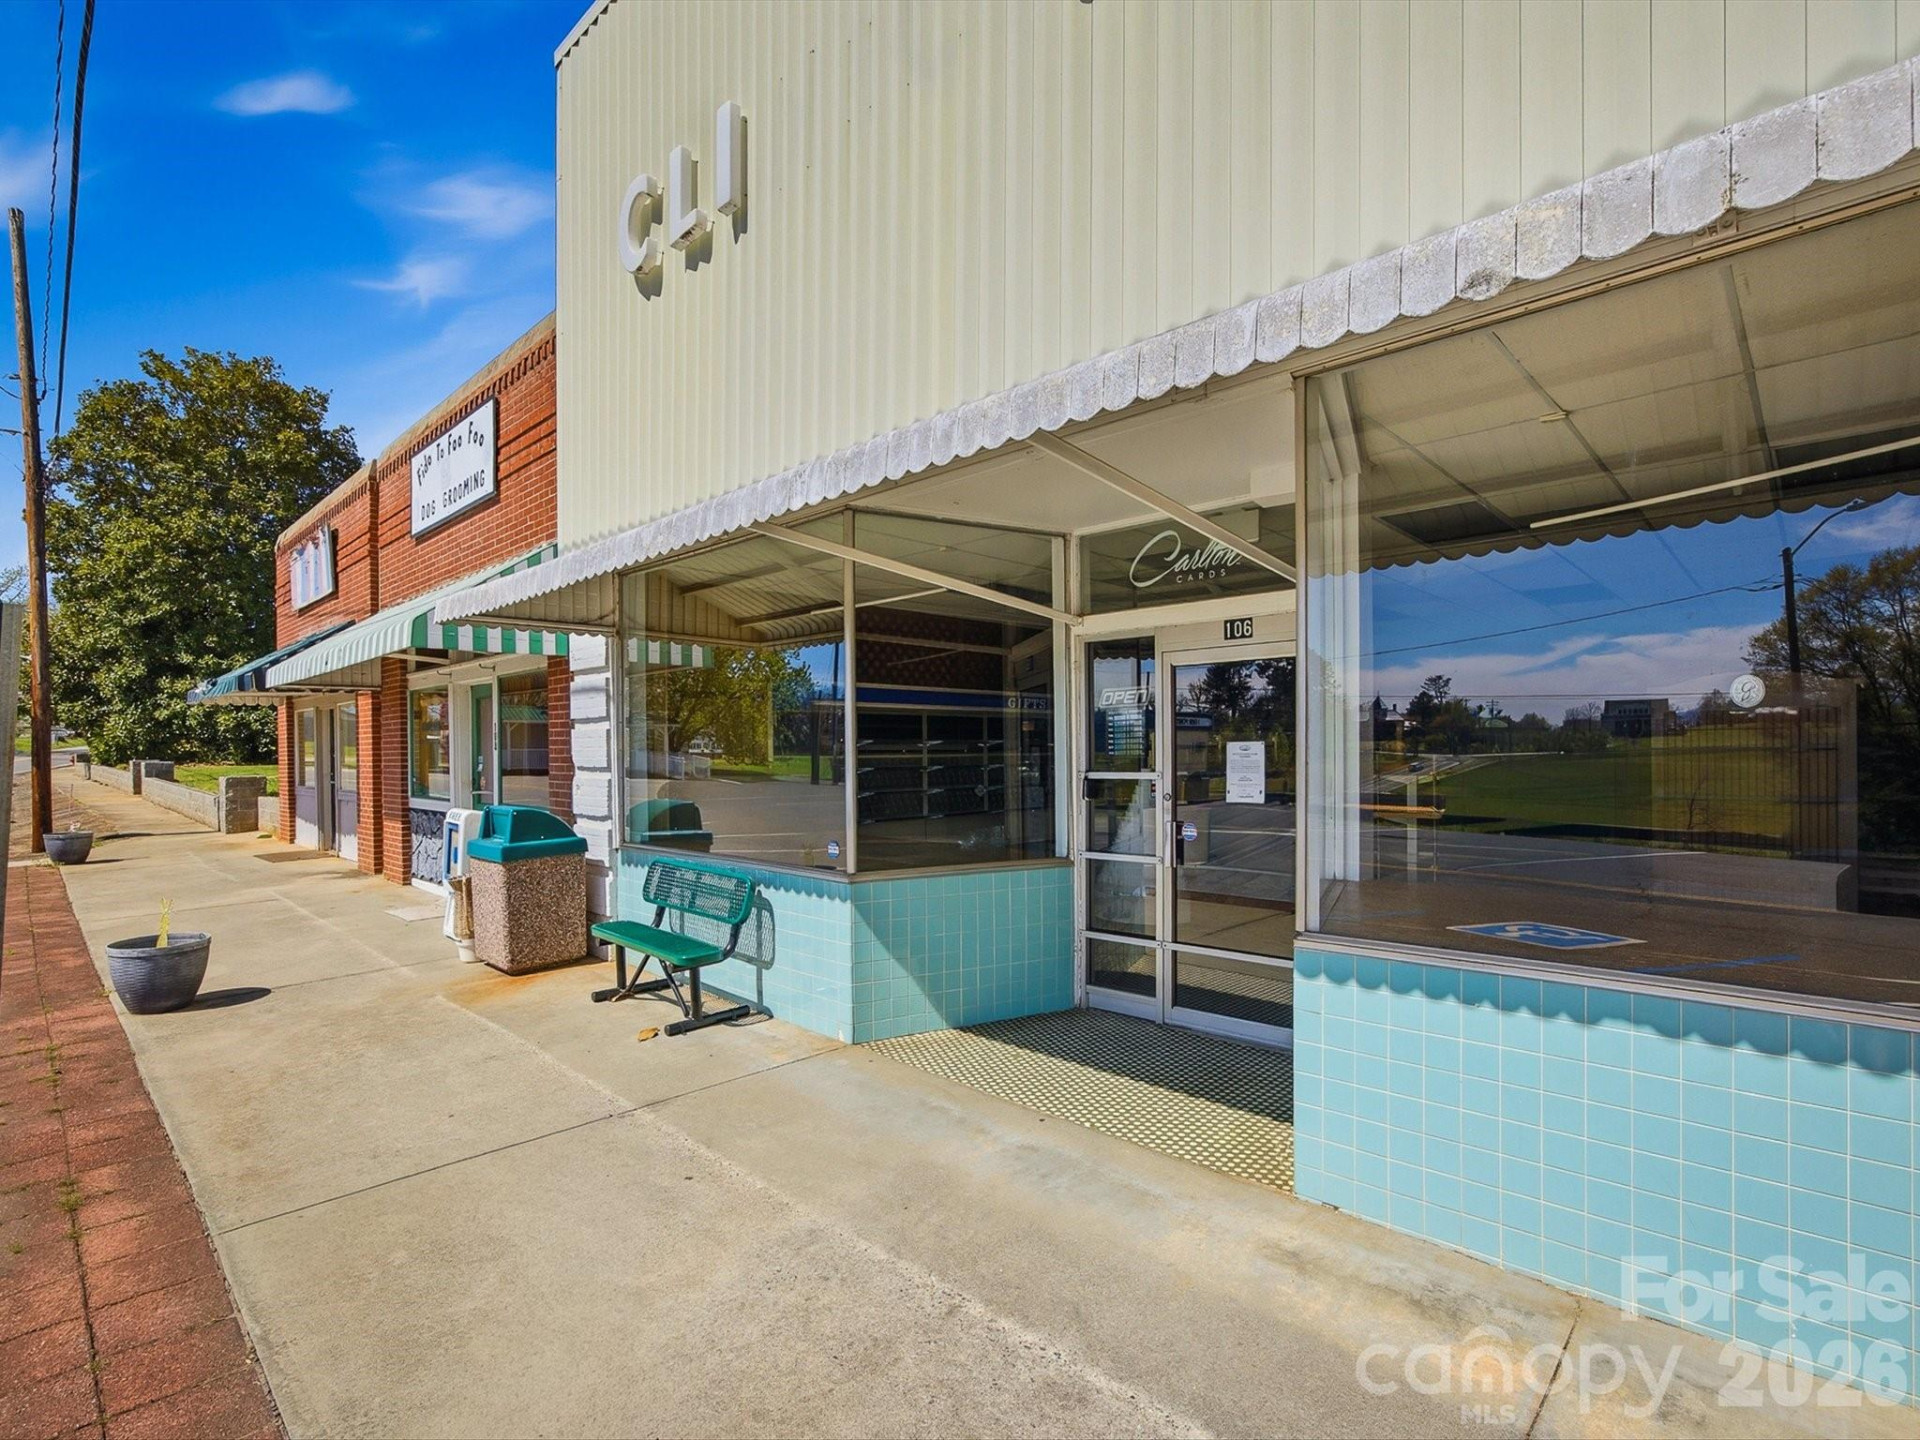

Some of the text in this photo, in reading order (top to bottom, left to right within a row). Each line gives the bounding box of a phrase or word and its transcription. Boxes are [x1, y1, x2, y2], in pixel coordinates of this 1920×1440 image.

[416, 420, 485, 487] Fido To Foo Foo
[421, 469, 485, 521] DOG GROOMING
[1129, 529, 1242, 588] Carlton
[1175, 568, 1227, 584] CARDS
[1225, 619, 1252, 639] 106
[1007, 696, 1048, 710] GIFTS
[1101, 689, 1148, 706] OPEN
